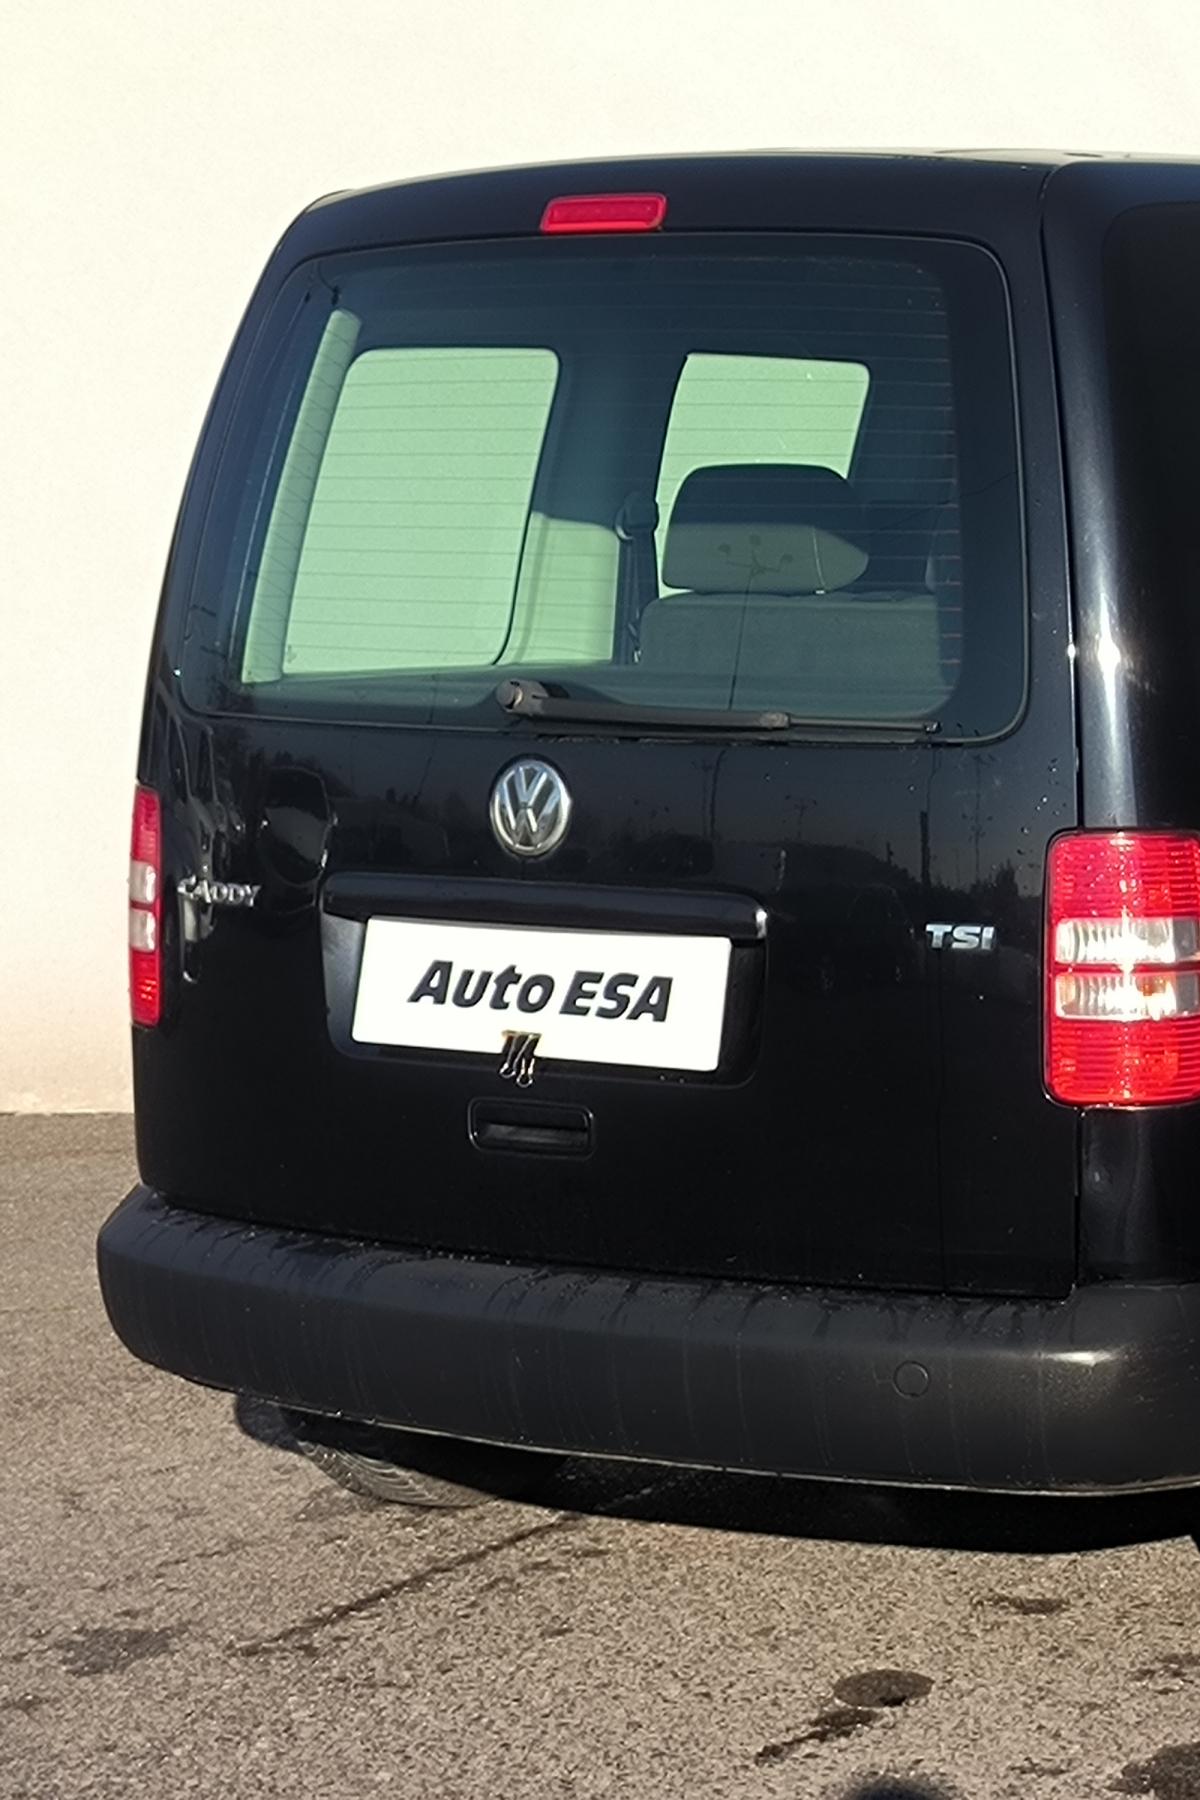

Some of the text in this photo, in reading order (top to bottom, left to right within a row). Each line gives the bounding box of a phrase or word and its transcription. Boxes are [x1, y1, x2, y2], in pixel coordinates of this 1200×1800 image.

[925, 923, 995, 950] TSI
[407, 959, 674, 1023] Auto ESA
